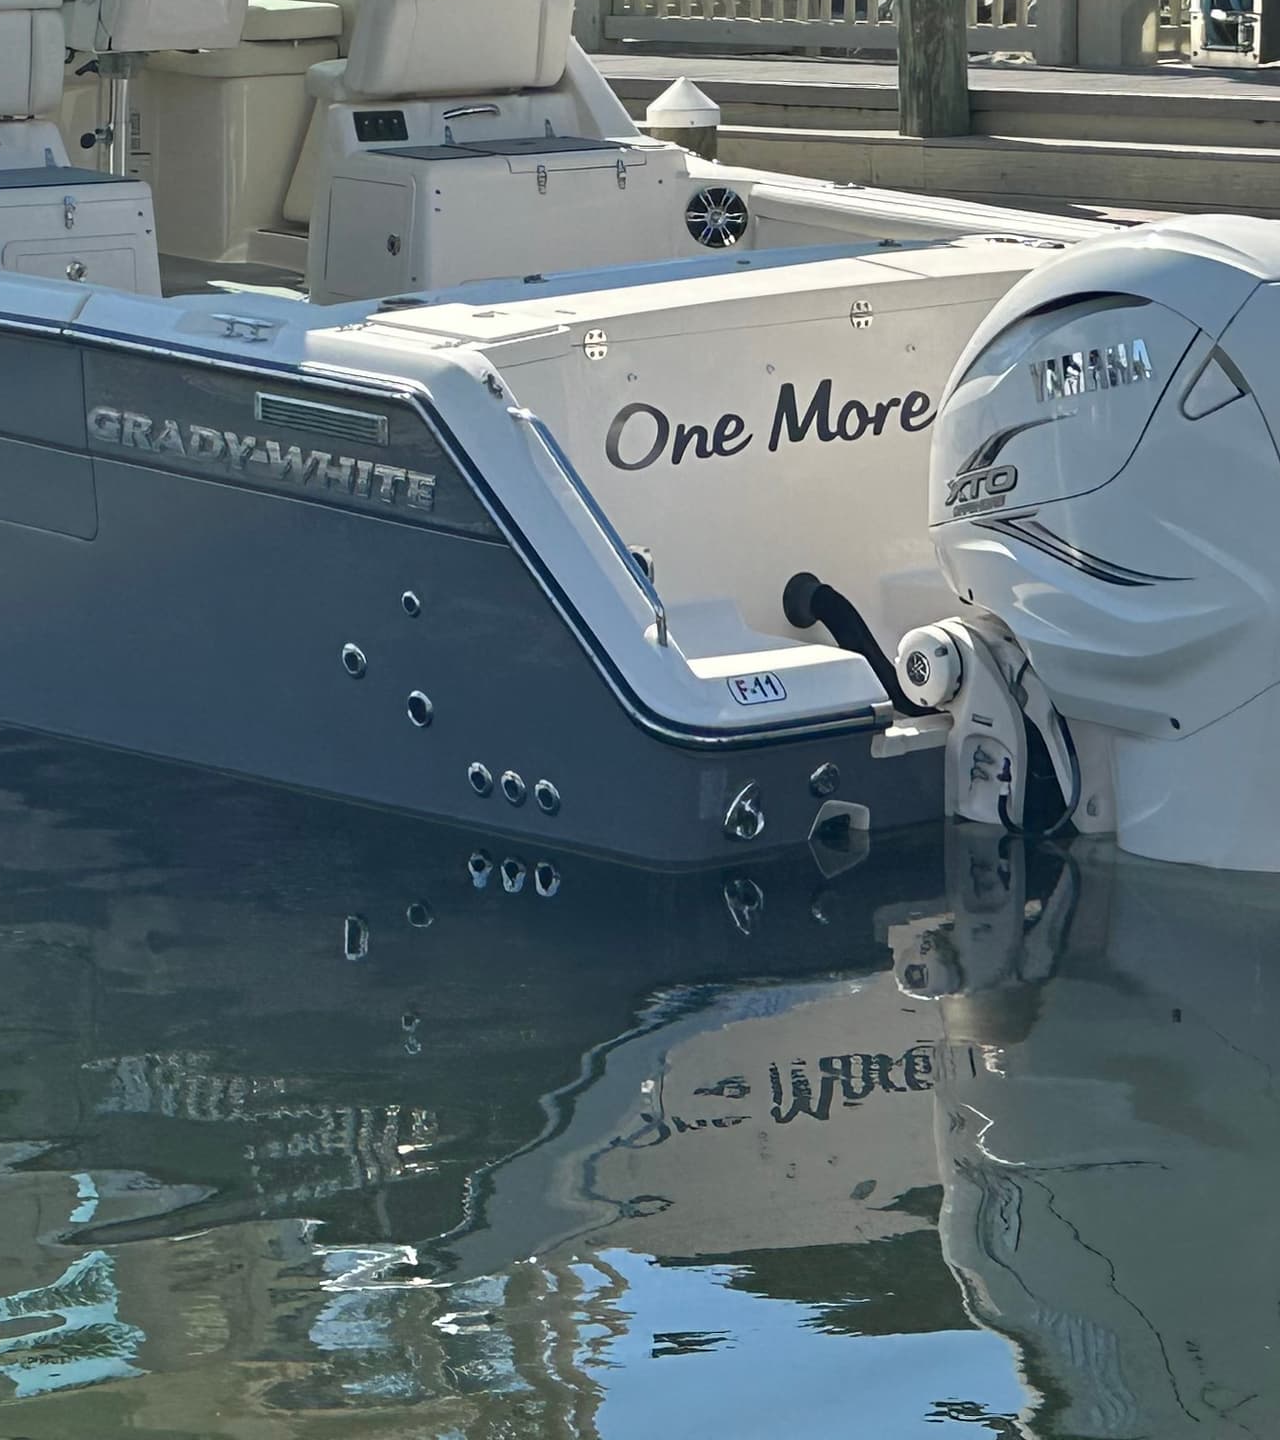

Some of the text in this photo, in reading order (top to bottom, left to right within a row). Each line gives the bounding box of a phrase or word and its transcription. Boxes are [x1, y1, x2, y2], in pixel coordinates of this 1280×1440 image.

[1028, 337, 1154, 404] YAMAHA
[605, 378, 938, 471] One More
[945, 464, 1018, 507] XTO
[734, 674, 780, 701] F-11
